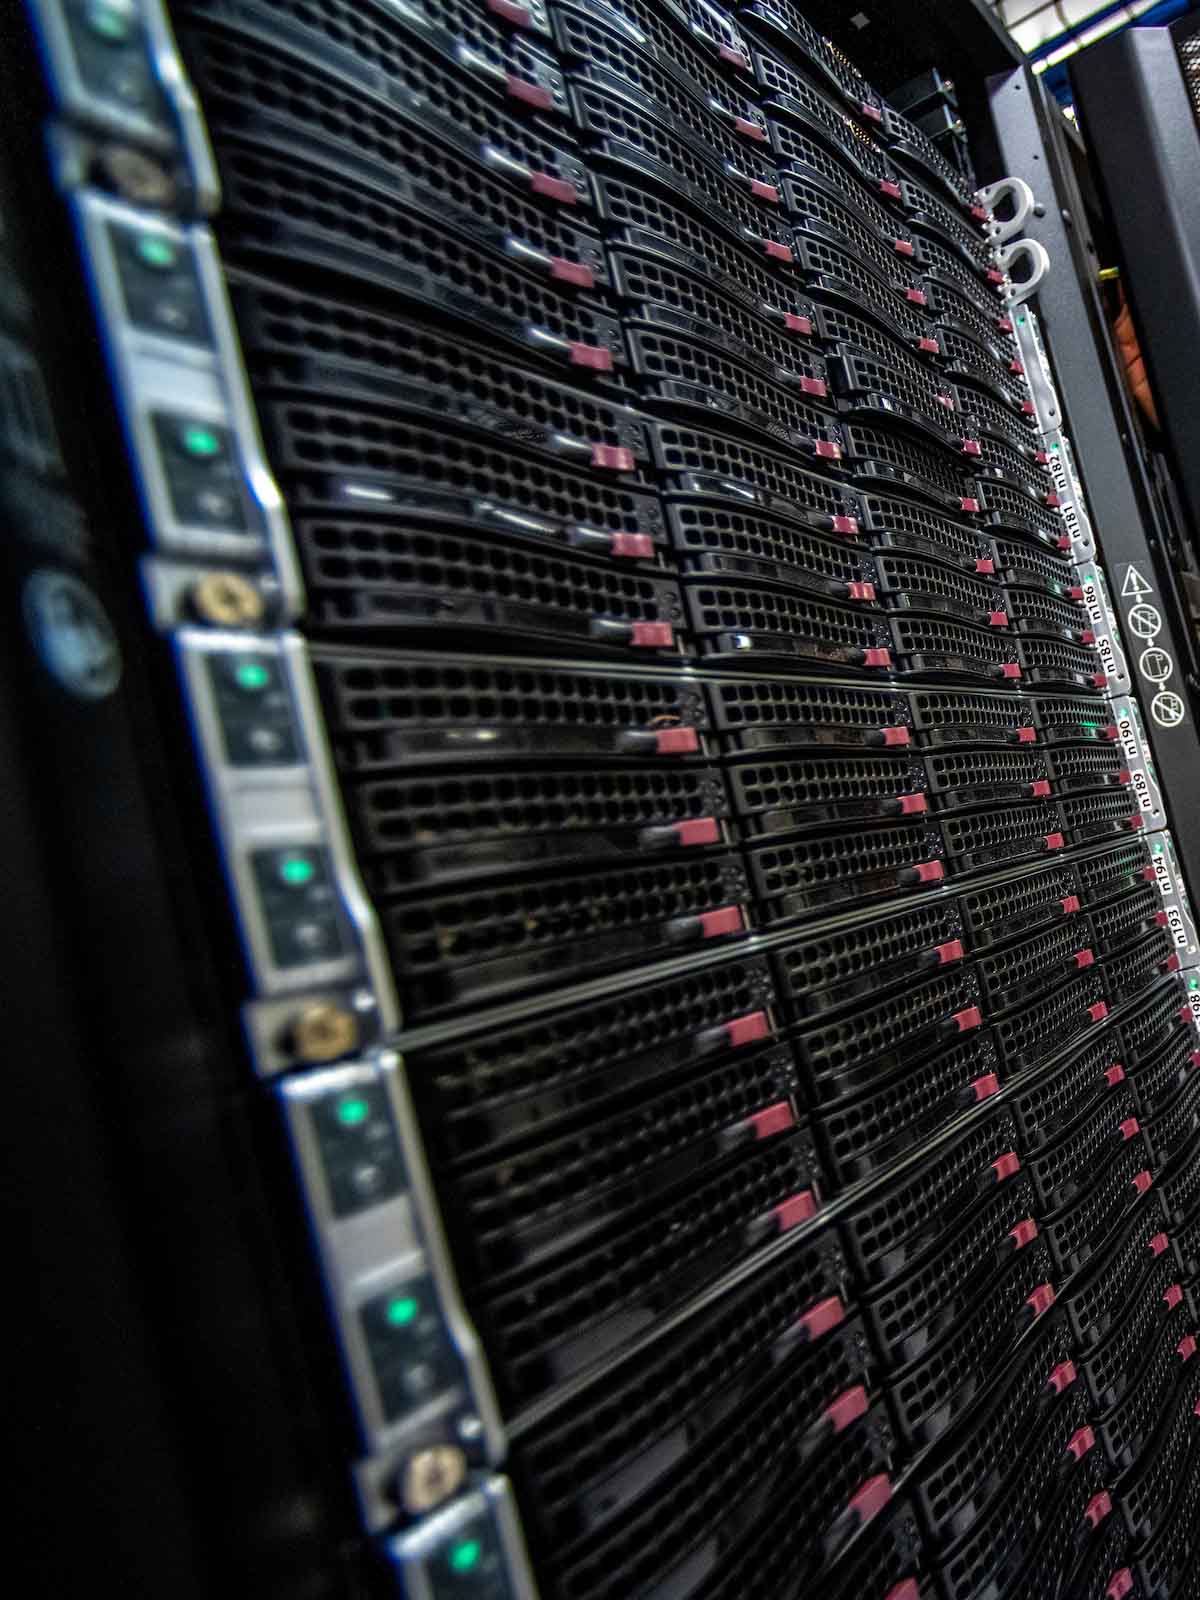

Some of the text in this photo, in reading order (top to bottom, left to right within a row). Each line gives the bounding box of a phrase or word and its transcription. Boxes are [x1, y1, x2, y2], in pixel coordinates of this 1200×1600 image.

[1050, 453, 1067, 489] n182
[1064, 506, 1081, 539] n181
[1084, 586, 1102, 621] n186
[1098, 638, 1115, 673] n185
[1119, 720, 1137, 755] n190
[1133, 773, 1151, 808] n189
[1153, 856, 1171, 892] n194
[1168, 910, 1186, 944] n193
